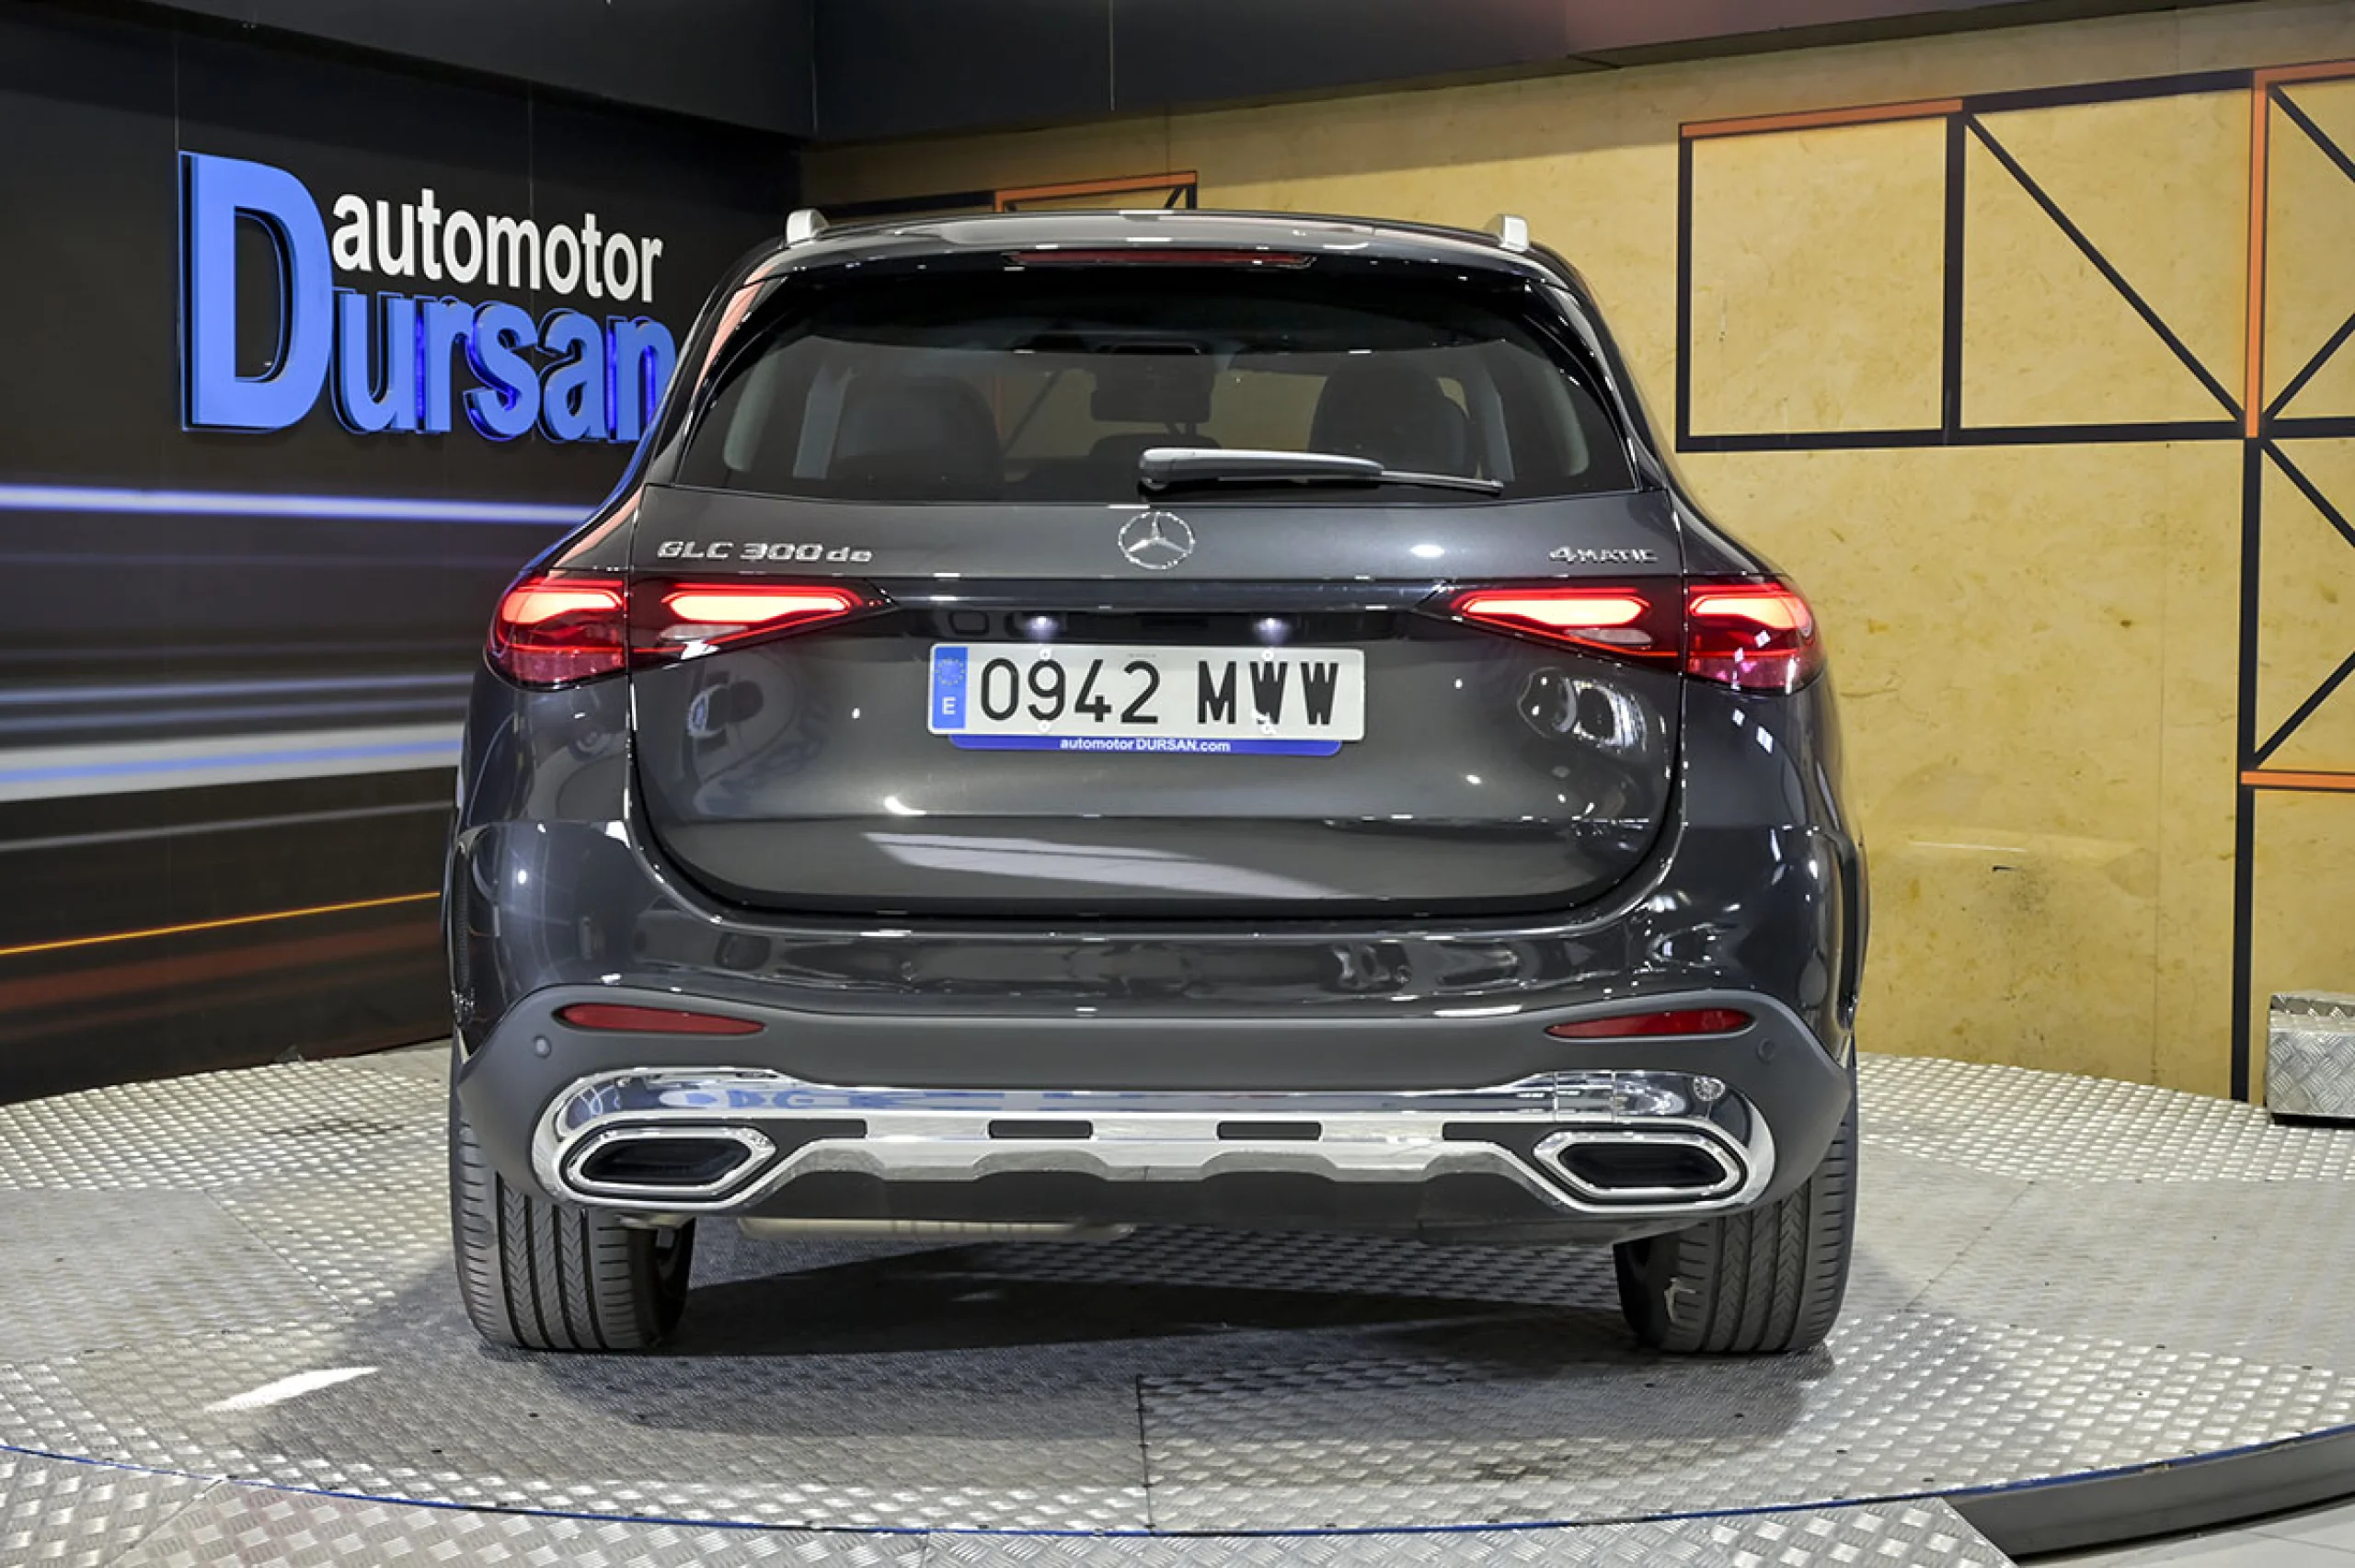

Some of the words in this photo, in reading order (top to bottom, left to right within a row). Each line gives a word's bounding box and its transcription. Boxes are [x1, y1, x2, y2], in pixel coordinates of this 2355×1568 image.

[331, 189, 663, 302] automotor
[178, 151, 678, 443] Dursan
[657, 541, 734, 558] GLC
[740, 543, 823, 560] 300
[826, 546, 873, 562] de
[1549, 545, 1659, 562] 4MATIC
[980, 658, 1161, 724] 0942
[1198, 660, 1339, 725] MWW
[942, 696, 957, 715] E
[1059, 738, 1134, 750] automotor
[1135, 738, 1232, 752] DURSAN.com
